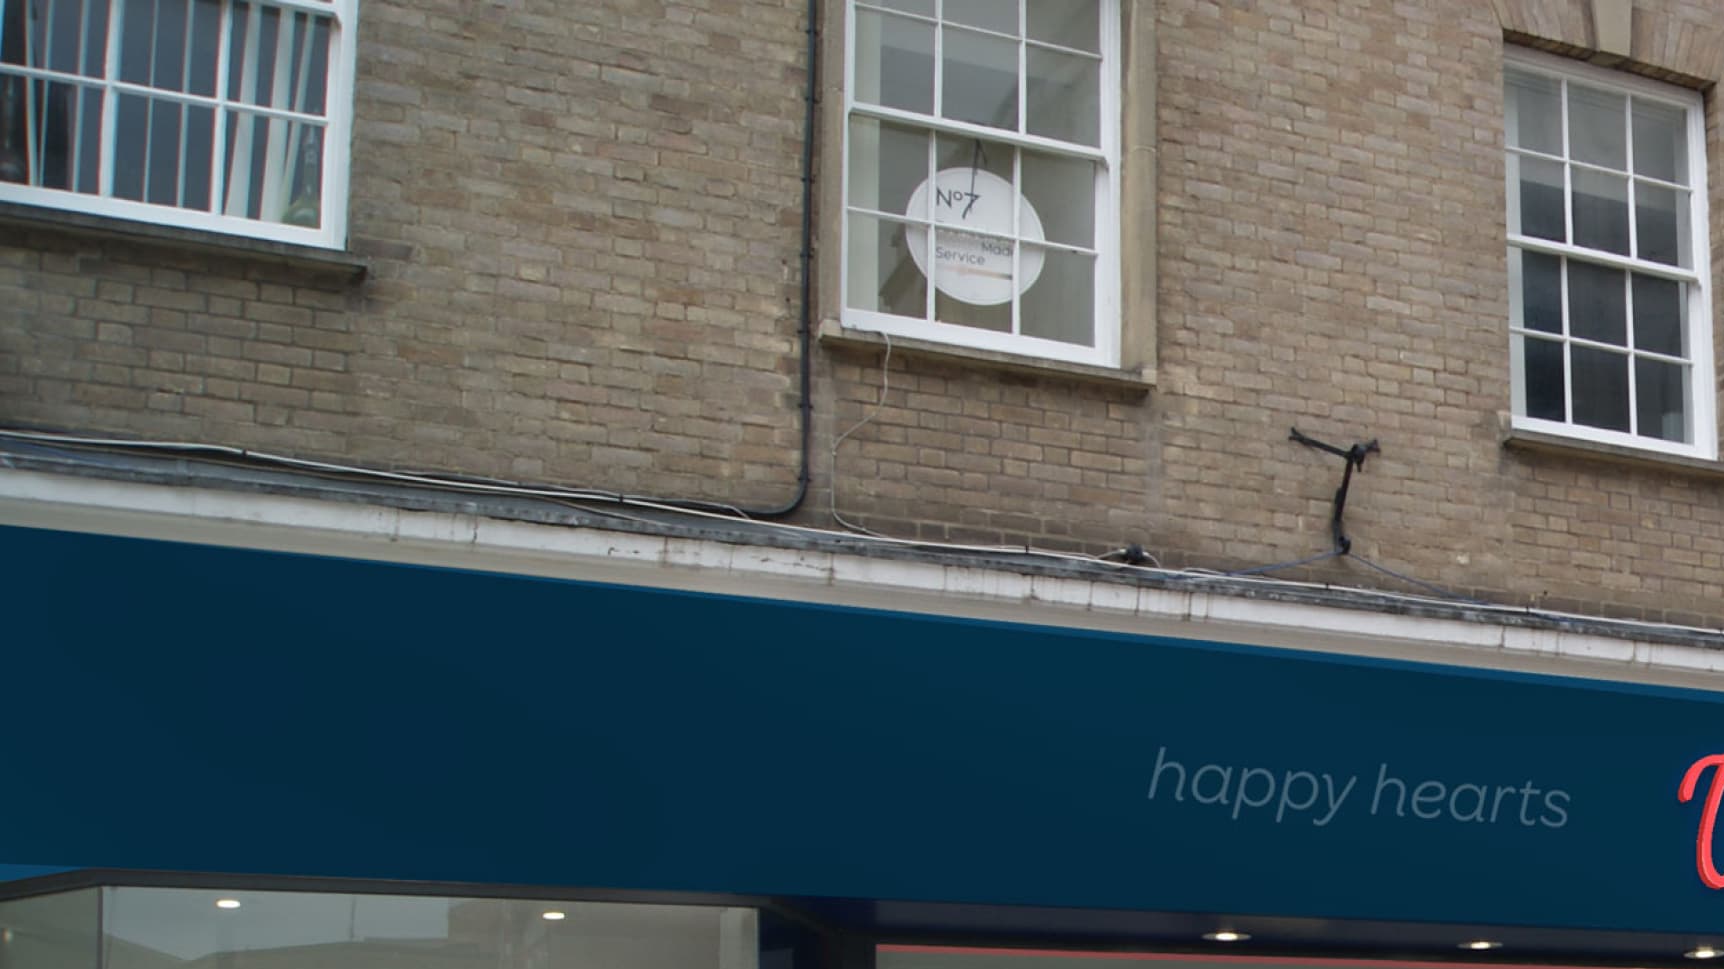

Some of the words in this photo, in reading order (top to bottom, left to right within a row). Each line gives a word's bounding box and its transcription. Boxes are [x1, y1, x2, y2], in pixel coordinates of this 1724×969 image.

[935, 245, 986, 267] Service
[1148, 746, 1357, 827] happy
[1369, 762, 1572, 828] hearts
